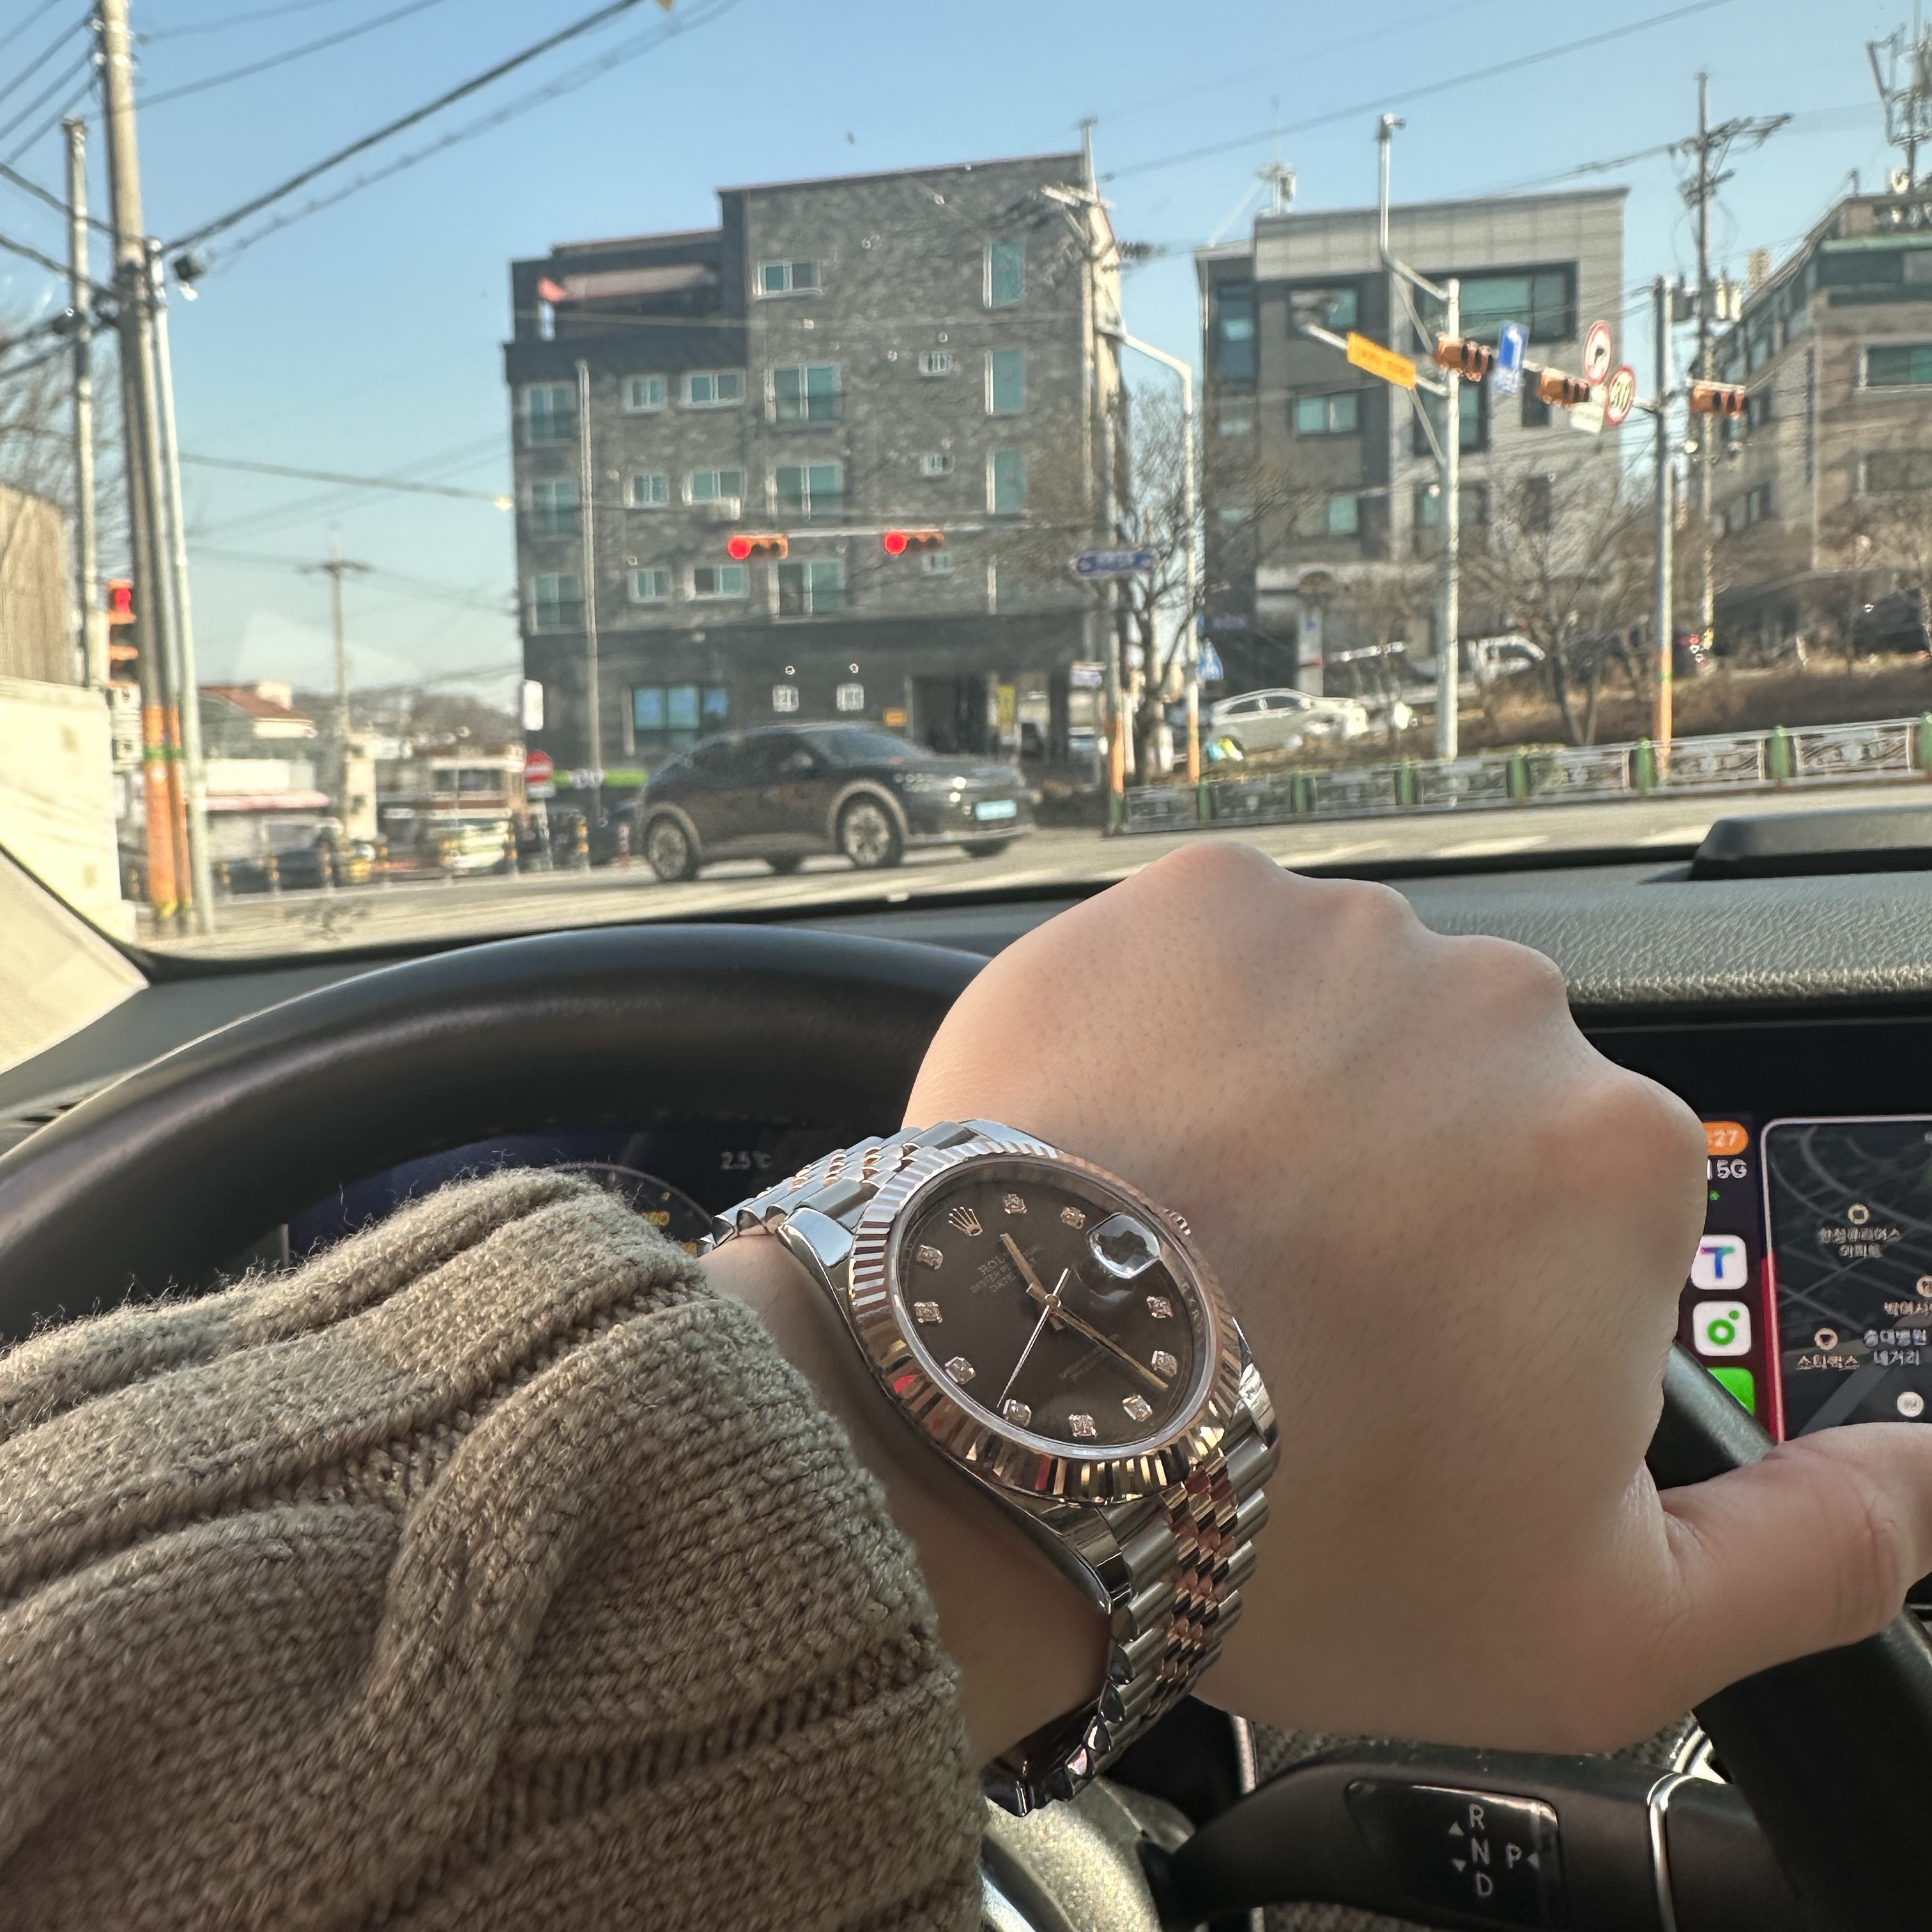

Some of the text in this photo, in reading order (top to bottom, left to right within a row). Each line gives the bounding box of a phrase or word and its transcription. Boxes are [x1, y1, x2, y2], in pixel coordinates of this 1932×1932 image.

[1717, 1158, 1747, 1179] 5G
[1468, 1803, 1485, 1830] R
[1471, 1837, 1491, 1866] N
[1505, 1842, 1522, 1869] P
[1476, 1871, 1494, 1897] D
